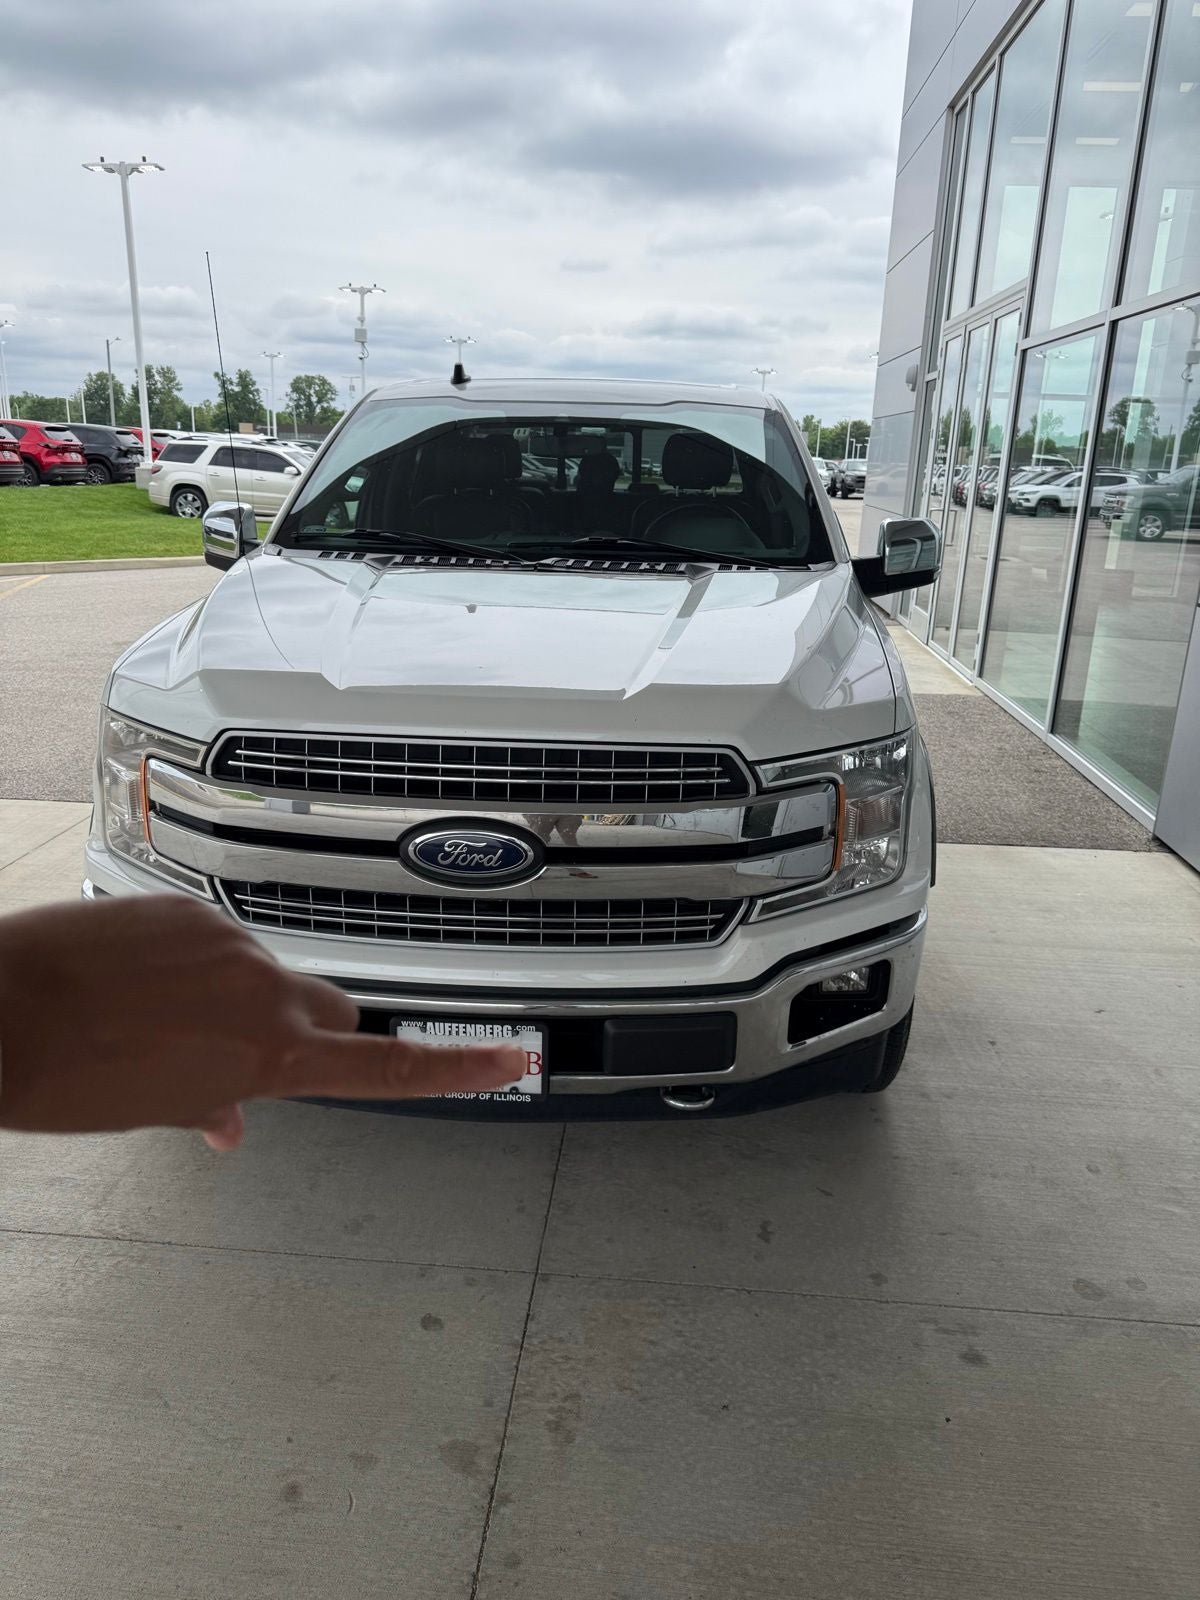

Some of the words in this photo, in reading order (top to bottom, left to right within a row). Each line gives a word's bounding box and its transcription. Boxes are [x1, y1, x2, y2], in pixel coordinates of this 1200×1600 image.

[437, 839, 503, 867] Ford
[444, 1091, 477, 1100] GROUP
[478, 1092, 492, 1100] OF
[493, 1093, 532, 1102] ILLINOIS
